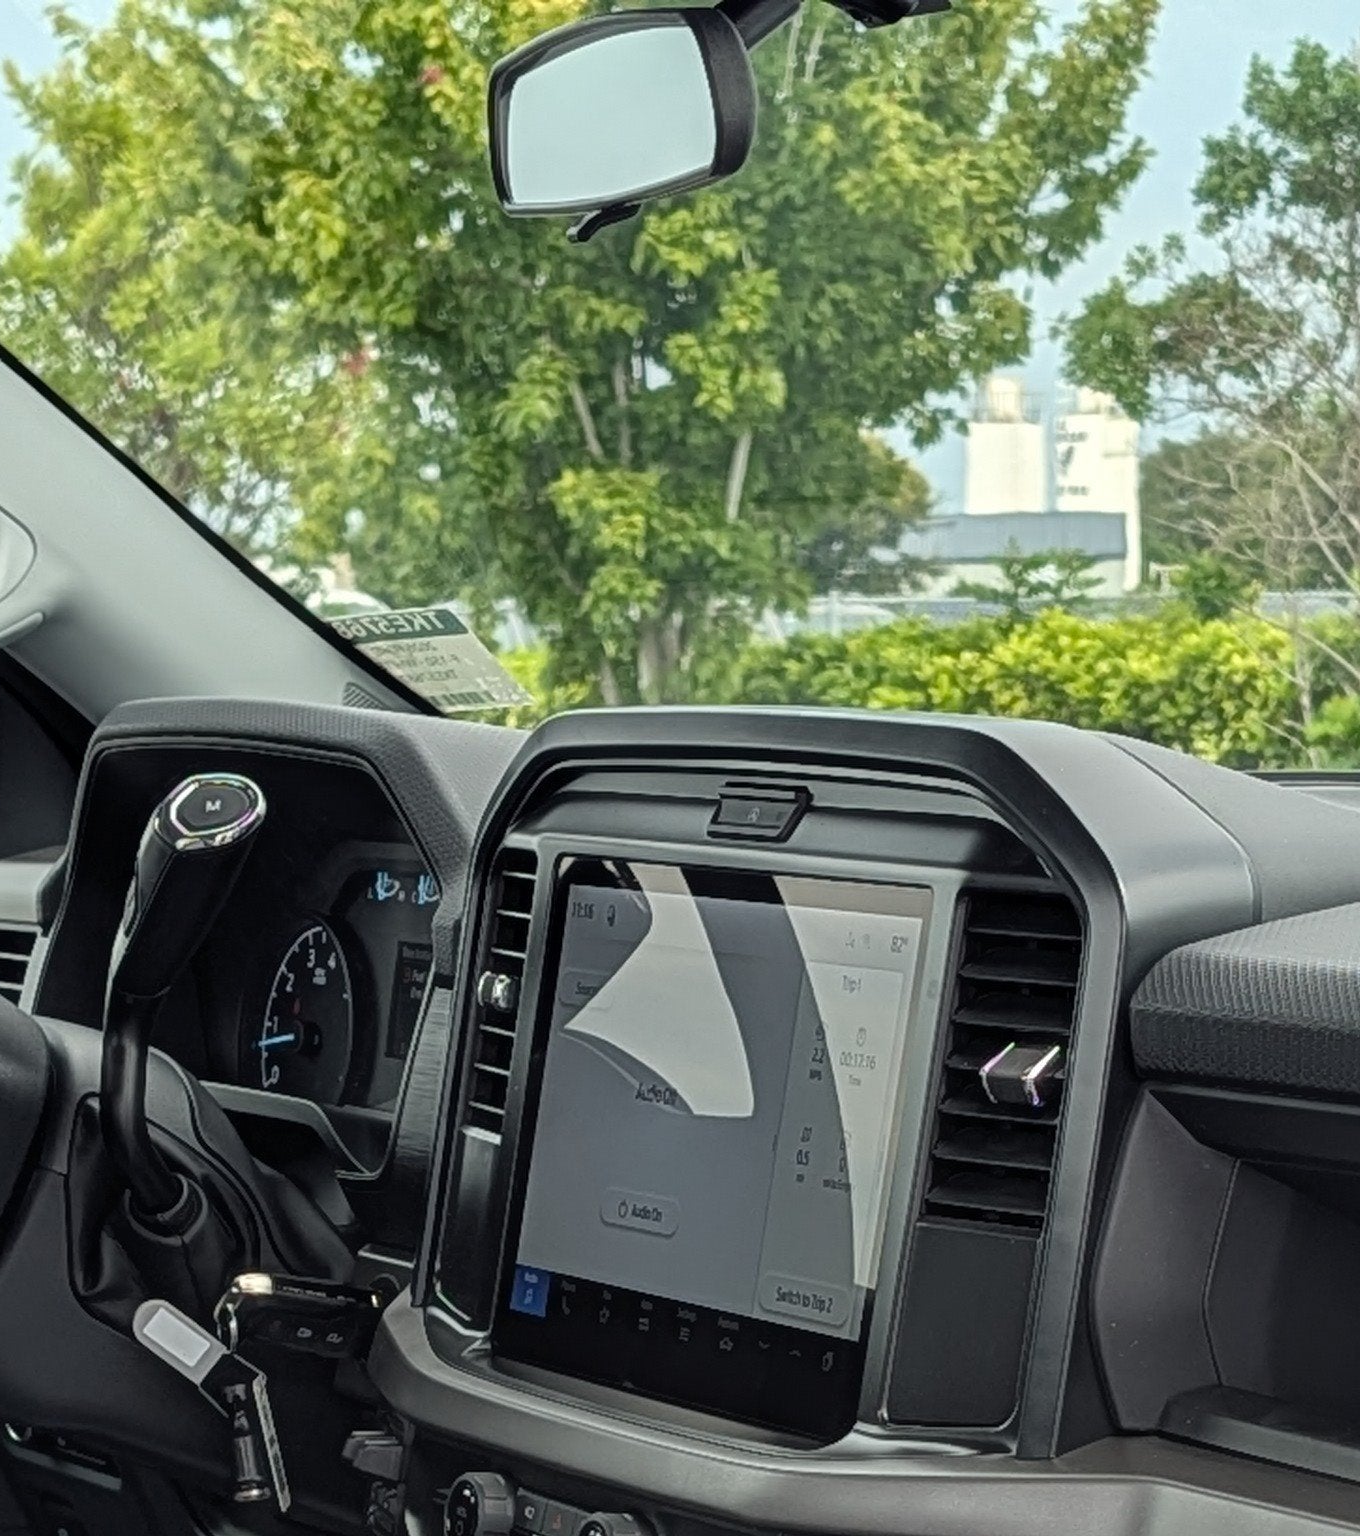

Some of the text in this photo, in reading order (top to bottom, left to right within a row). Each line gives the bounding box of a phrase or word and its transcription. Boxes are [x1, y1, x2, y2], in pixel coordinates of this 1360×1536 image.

[286, 973, 294, 992] 2
[775, 1286, 800, 1306] Switch
[811, 1293, 826, 1313] Trip
